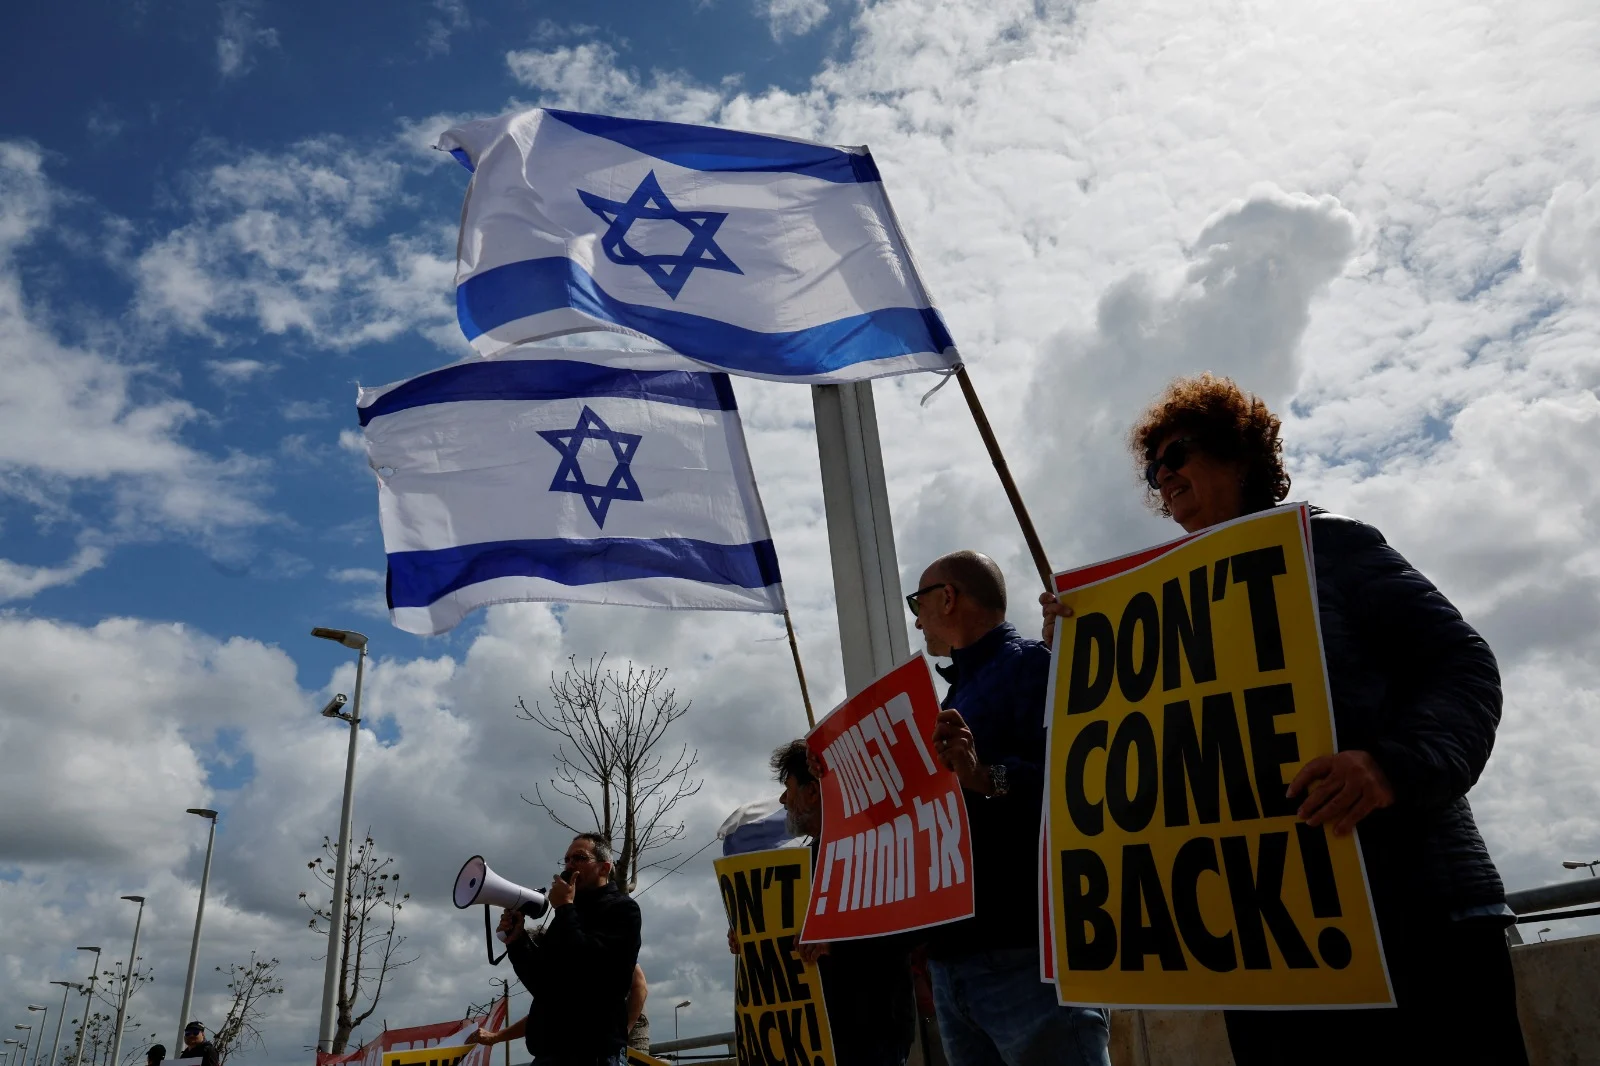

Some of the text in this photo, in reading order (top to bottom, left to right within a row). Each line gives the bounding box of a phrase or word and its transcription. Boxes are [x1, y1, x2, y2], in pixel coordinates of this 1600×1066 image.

[1066, 545, 1287, 715] DON'T
[822, 691, 938, 819] דיקטטור
[1065, 683, 1309, 837] COME
[720, 863, 801, 936] ON'T
[815, 791, 965, 916] אל תחזור!
[1060, 822, 1352, 973] BACK!
